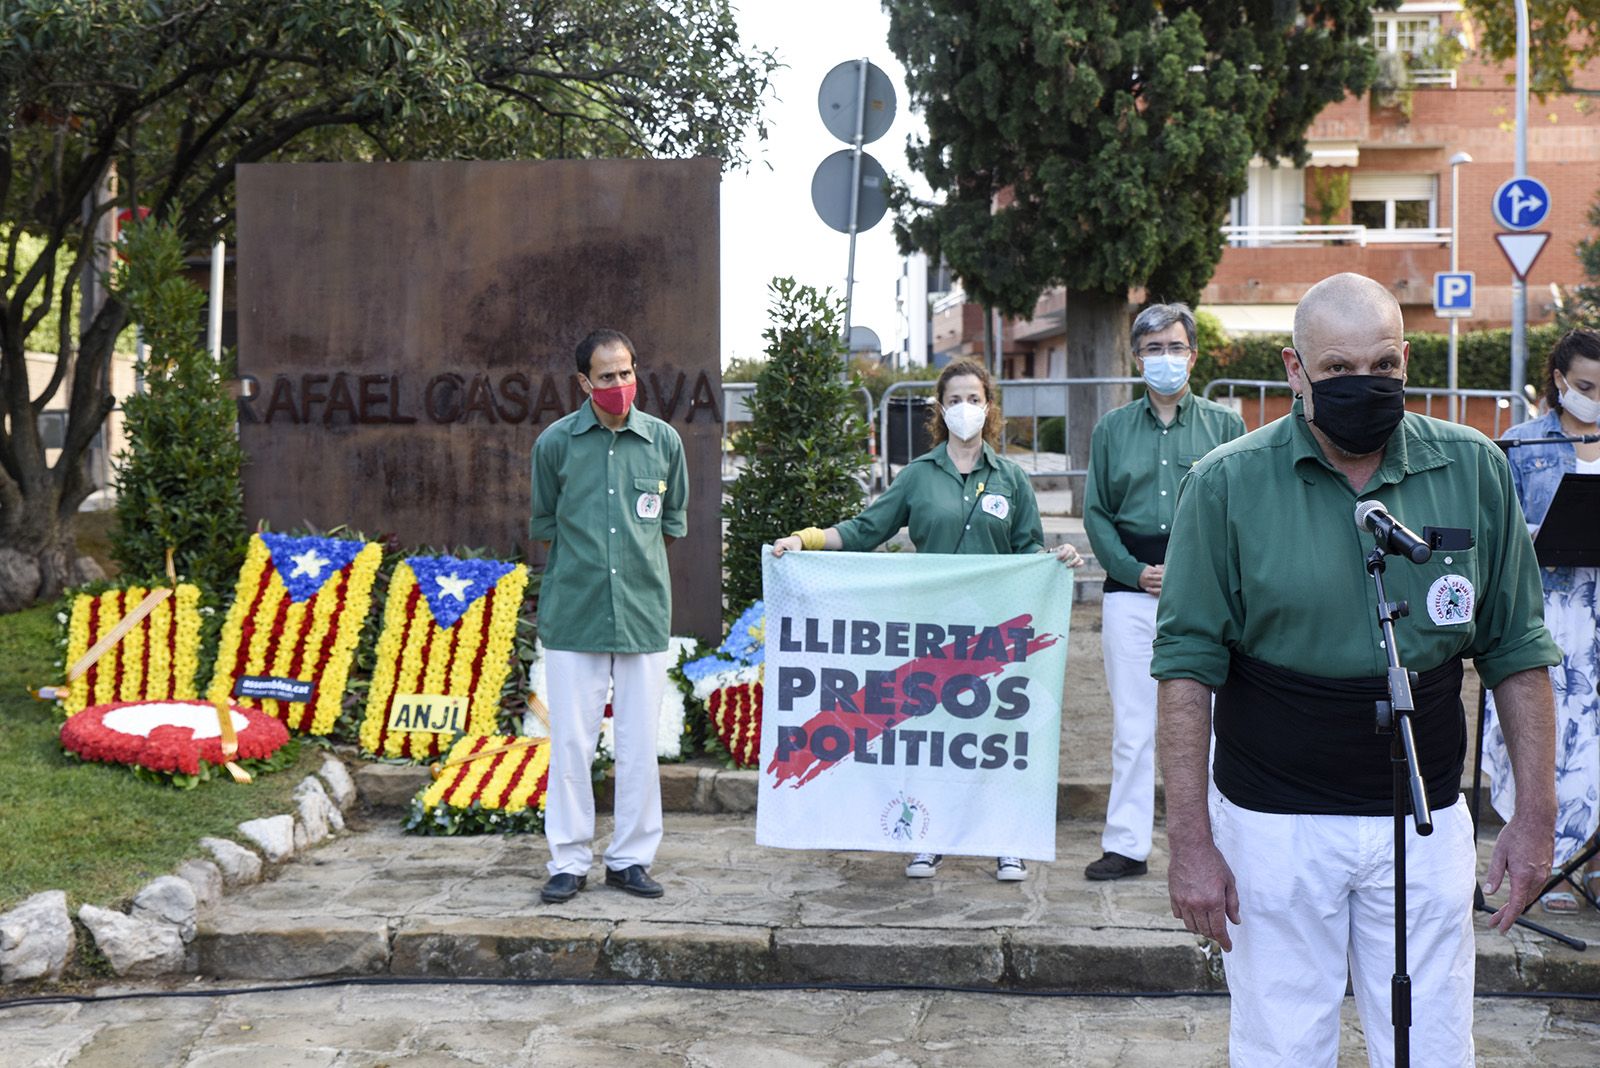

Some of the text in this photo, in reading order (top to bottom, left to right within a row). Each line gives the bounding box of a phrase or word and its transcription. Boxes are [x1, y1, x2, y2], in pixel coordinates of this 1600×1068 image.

[1443, 277, 1467, 306] P
[237, 371, 722, 425] RAFAEL CASAVA
[1435, 584, 1448, 619] CASTELLERS
[779, 616, 1035, 662] LLIBERTAT
[777, 666, 1031, 720] PRESOS
[777, 718, 1029, 770] POLÍTICS!
